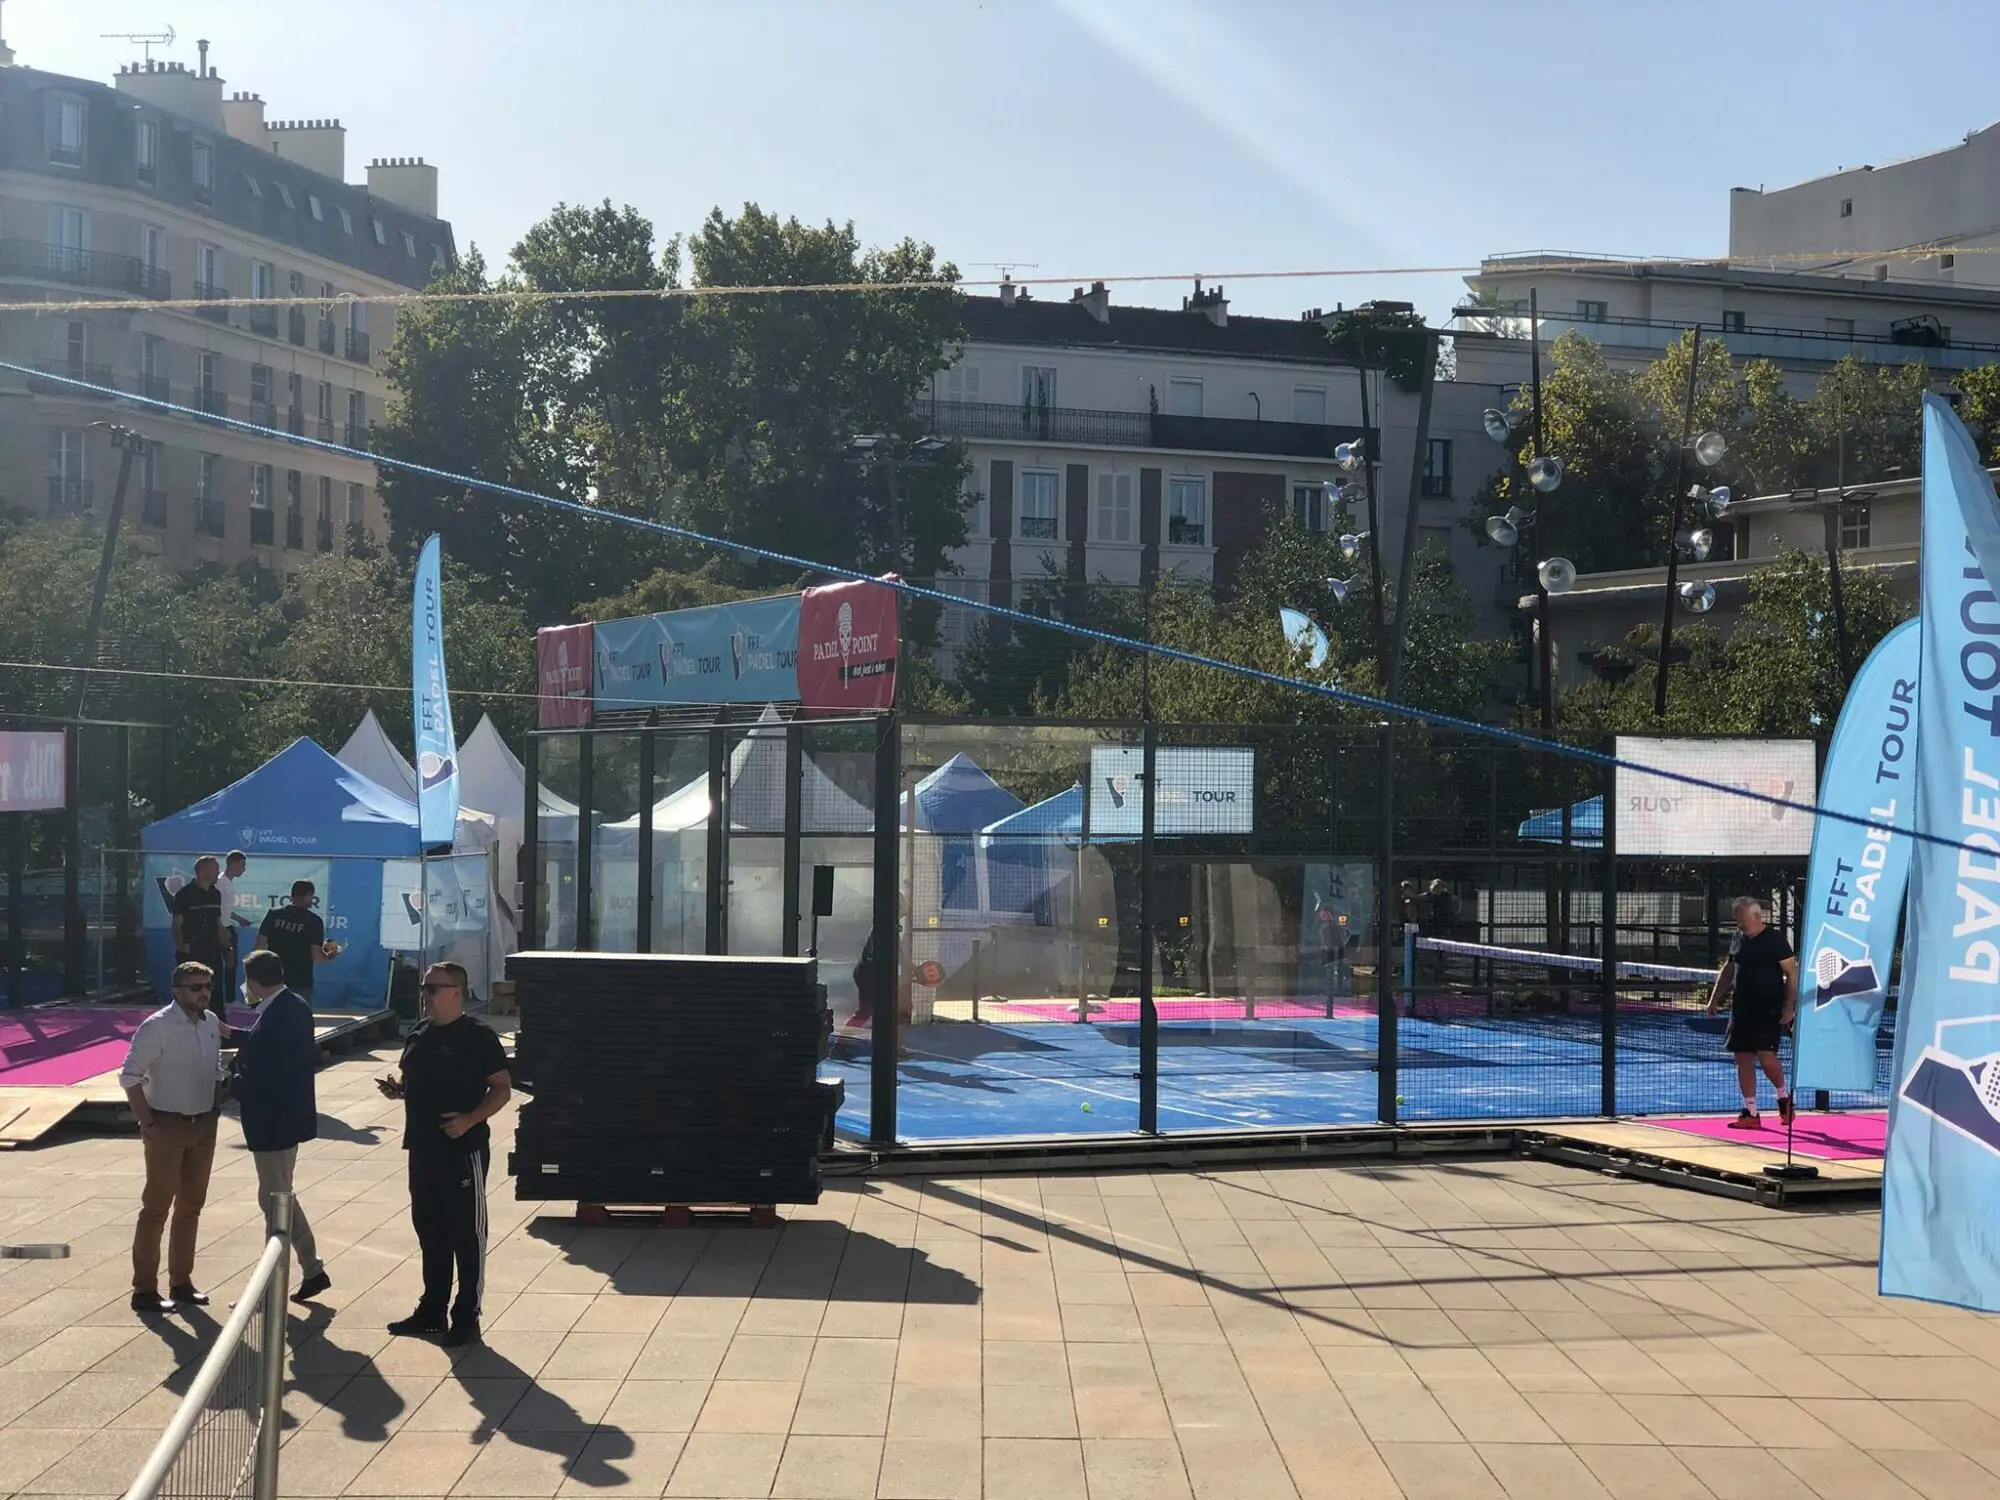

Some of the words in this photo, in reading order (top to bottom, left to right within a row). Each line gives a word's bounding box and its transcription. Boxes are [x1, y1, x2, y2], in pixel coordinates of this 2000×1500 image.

[425, 577, 436, 644] TOUR
[813, 640, 840, 660] PADEL
[852, 633, 878, 655] POINT
[698, 656, 721, 674] TOUR
[748, 652, 776, 671] PADEL
[430, 654, 445, 733] PADEL
[422, 694, 433, 731] FFT
[1193, 791, 1236, 803] TOUR
[1848, 798, 1896, 922] PADEL
[1875, 678, 1916, 785] TOUR
[259, 836, 288, 844] PADEL
[292, 836, 318, 845] TOUR
[1826, 857, 1853, 917] FFT
[274, 918, 305, 933] STAFF
